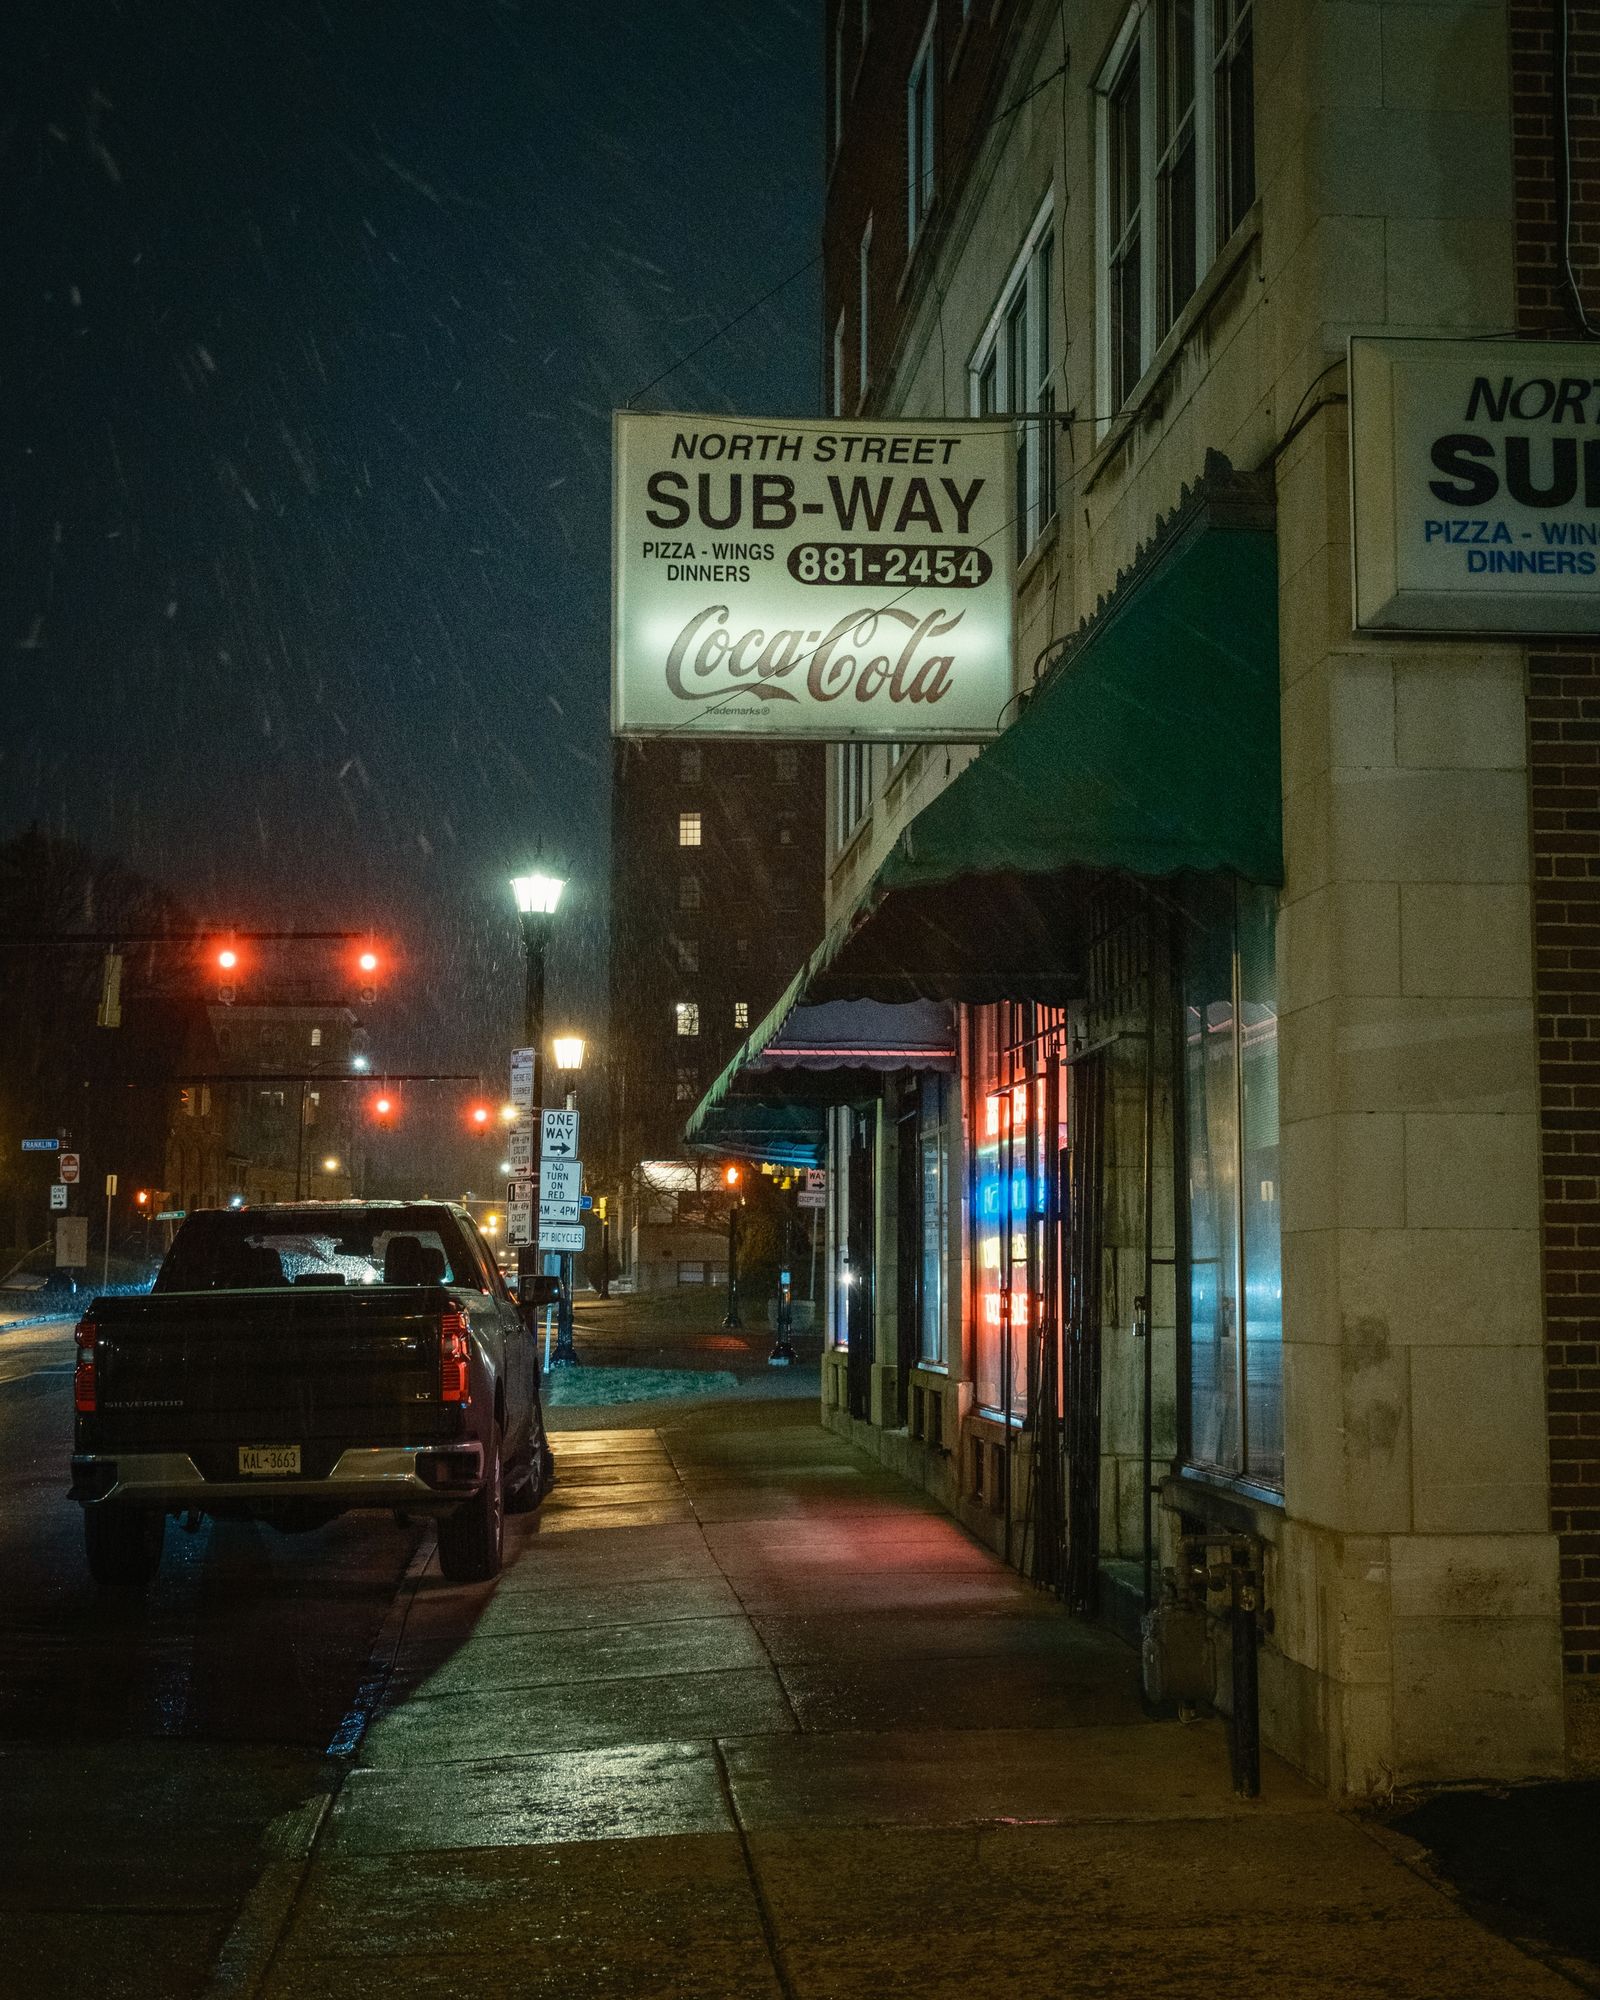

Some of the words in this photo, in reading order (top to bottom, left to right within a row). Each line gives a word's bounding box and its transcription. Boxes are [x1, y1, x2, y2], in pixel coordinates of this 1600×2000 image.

[1464, 376, 1600, 424] NOR
[671, 433, 804, 462] NORTH
[813, 435, 961, 465] STREET
[1428, 433, 1600, 508] SU
[645, 470, 986, 534] SUB-WAY
[1424, 520, 1513, 544] PIZZA
[1541, 522, 1600, 545] WIN
[642, 542, 696, 560] PIZZA
[712, 543, 775, 561] WINGS
[799, 547, 982, 585] 881-2454
[1468, 550, 1596, 575] DINNERS
[667, 564, 750, 583] DINNERS
[665, 604, 967, 705] Coca-Cola
[547, 1114, 574, 1126] ONE
[546, 1128, 574, 1139] WAY
[547, 1172, 569, 1181] TURN
[552, 1163, 564, 1172] NO
[810, 1171, 826, 1180] WAY
[548, 1190, 565, 1200] RED
[551, 1182, 563, 1190] ON
[540, 1205, 550, 1215] AM
[560, 1206, 576, 1216] 4PM
[551, 1232, 582, 1243] BICYCLES
[243, 1453, 262, 1469] KAL
[270, 1452, 296, 1468] 3663
